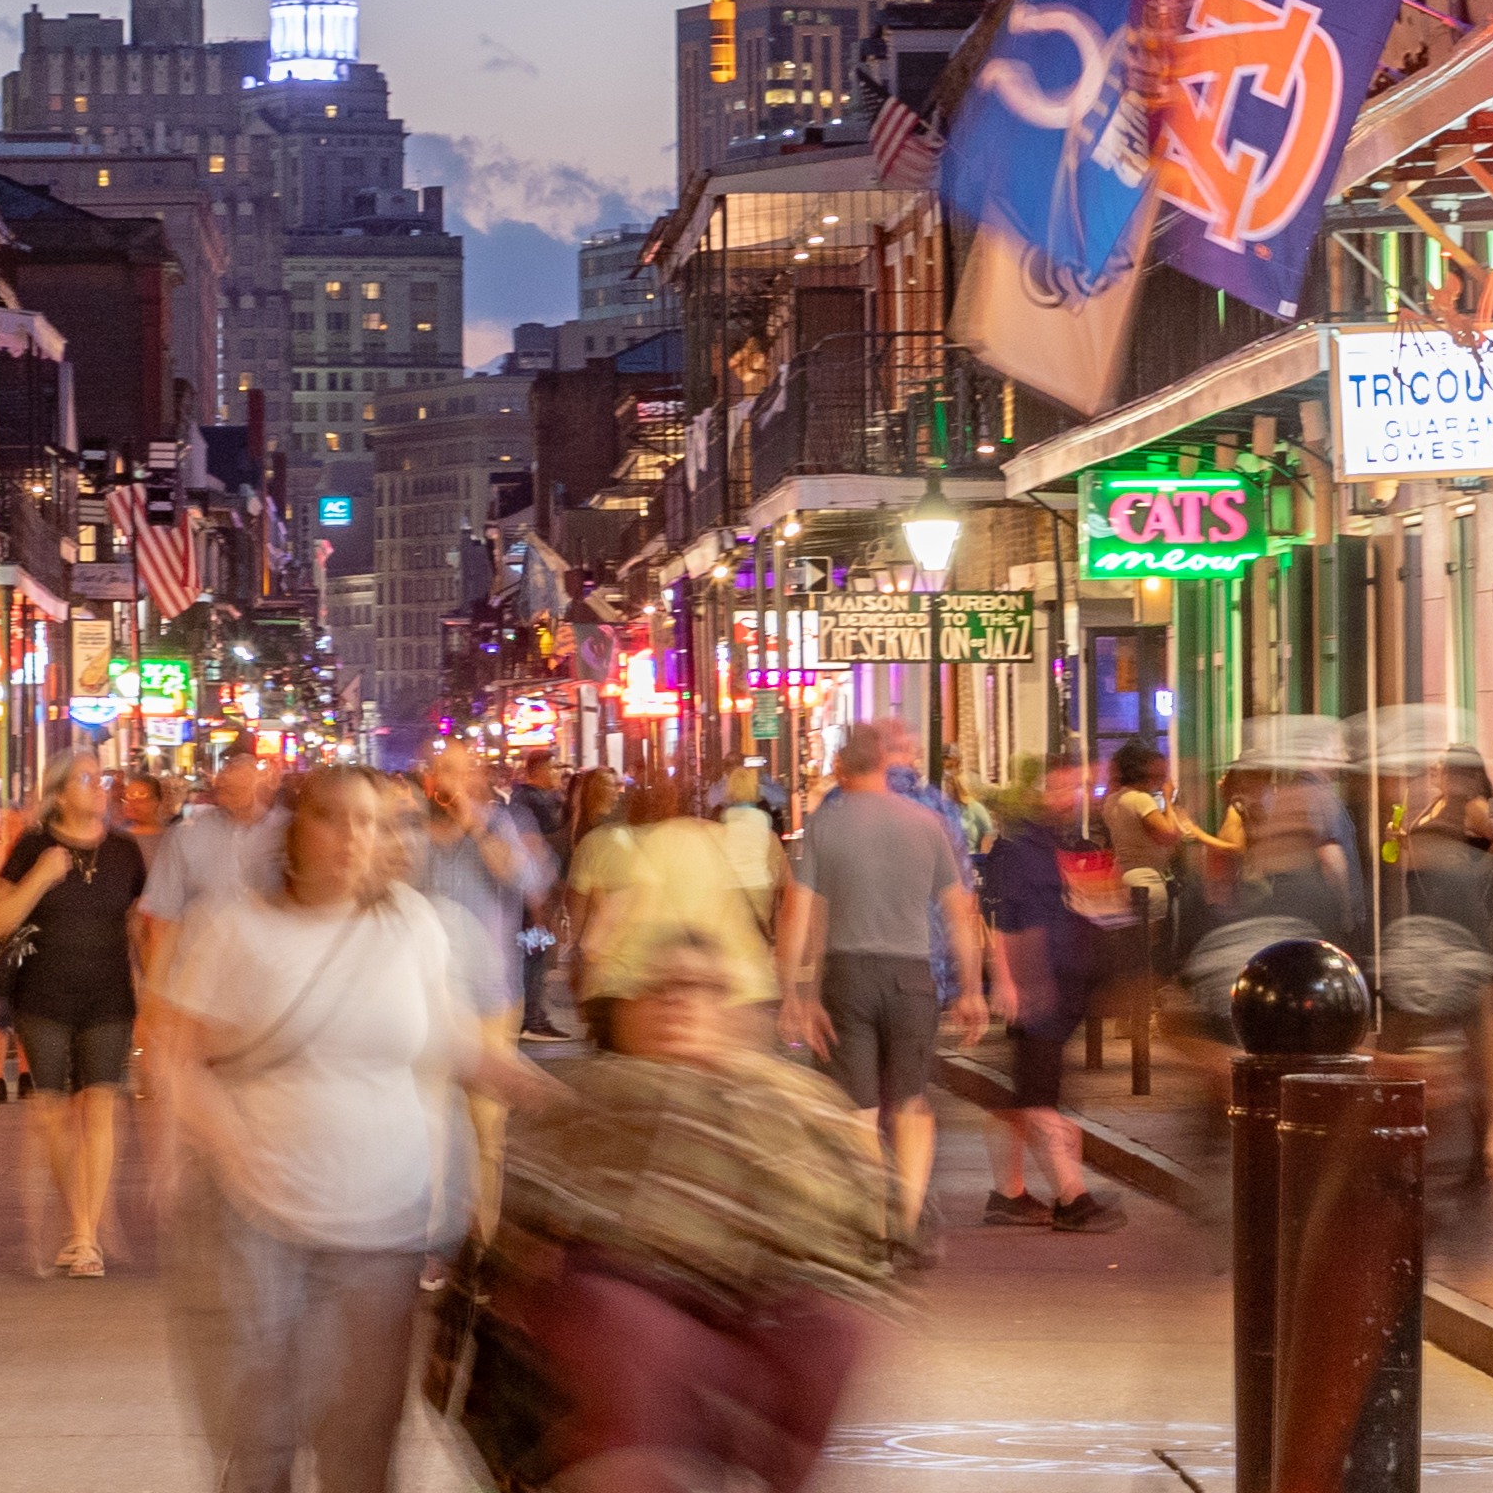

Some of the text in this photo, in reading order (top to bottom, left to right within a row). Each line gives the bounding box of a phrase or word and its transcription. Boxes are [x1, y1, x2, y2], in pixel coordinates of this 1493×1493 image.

[1349, 369, 1485, 408] TRICOU
[1366, 439, 1480, 463] LOWEST
[323, 500, 348, 513] AC
[1109, 488, 1250, 544] CATS
[1093, 549, 1261, 572] meow
[822, 595, 910, 612] MAISON
[940, 613, 968, 627] TO
[977, 613, 1017, 627] THE
[819, 615, 972, 661] PRESERVATON
[978, 615, 1033, 661] JAZZ
